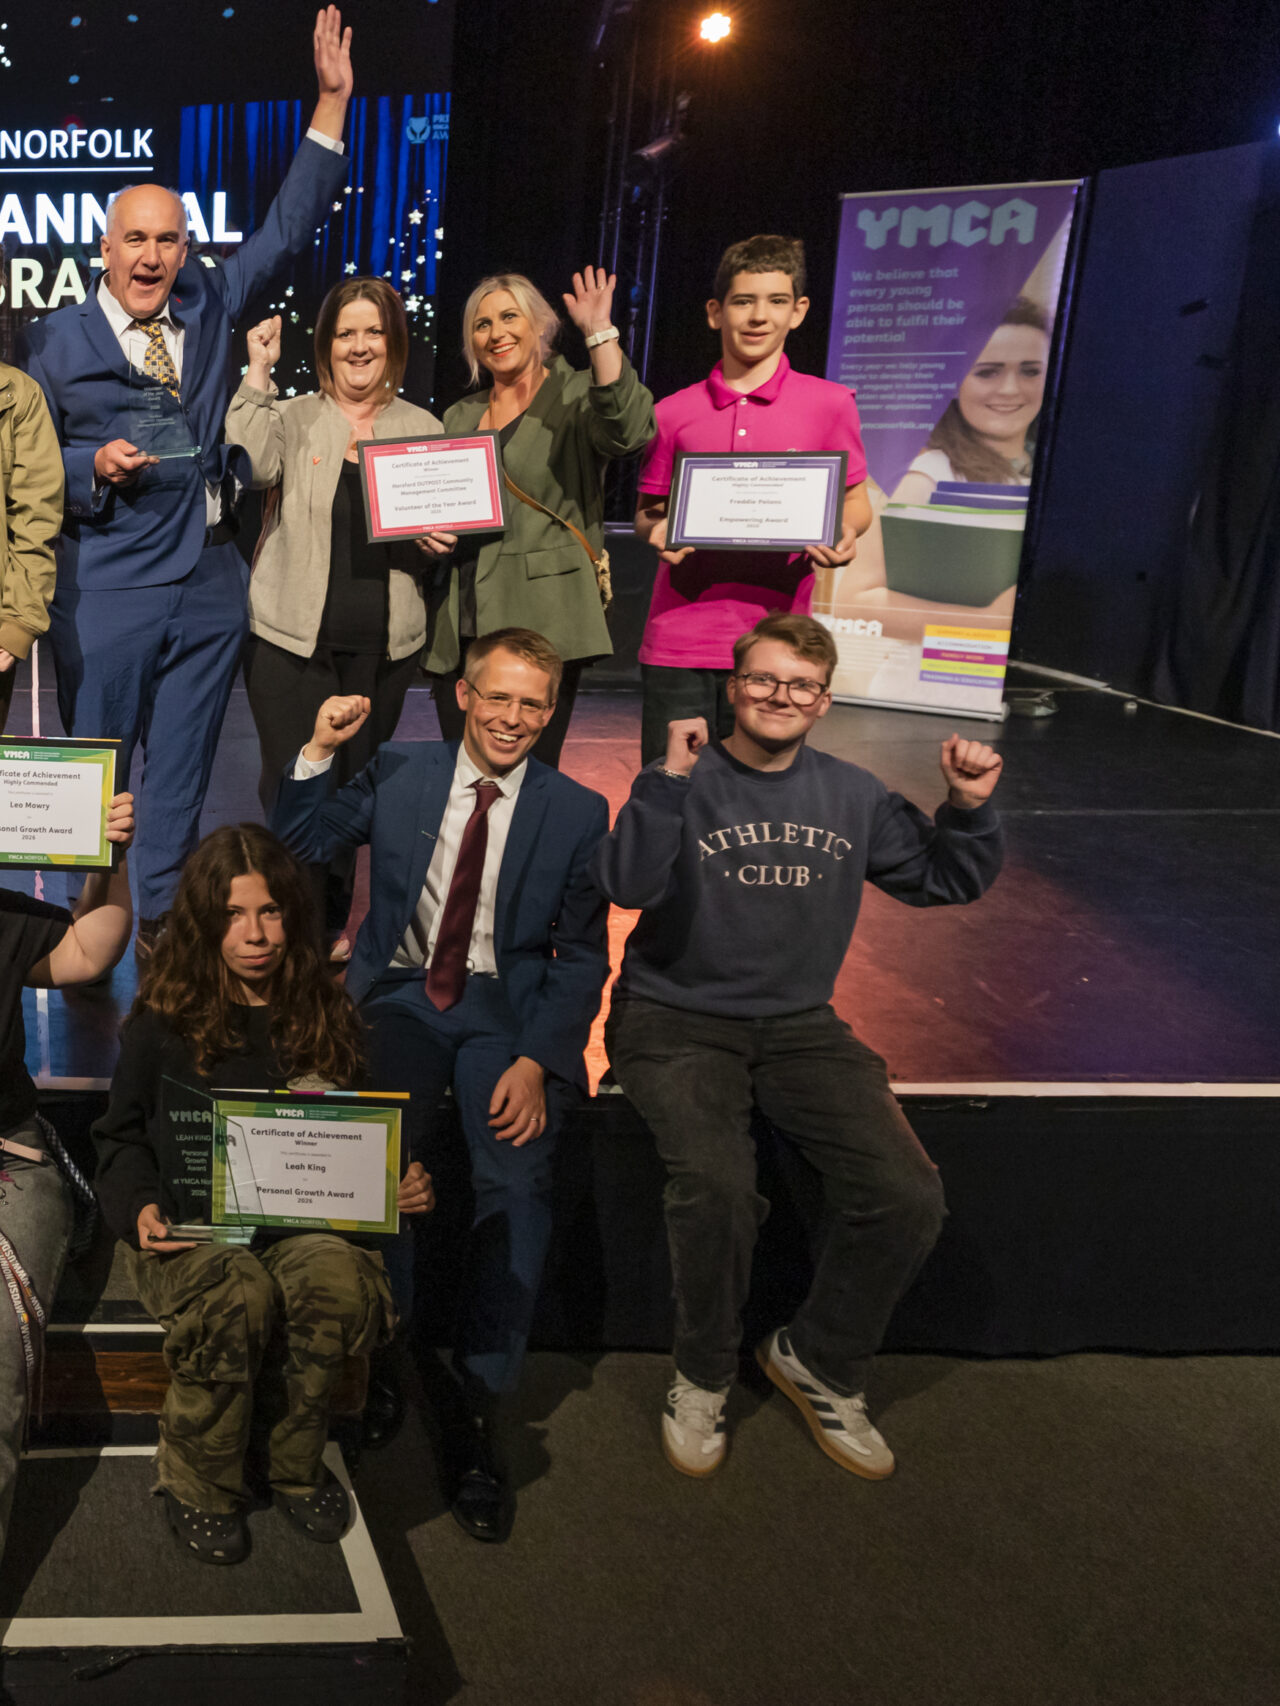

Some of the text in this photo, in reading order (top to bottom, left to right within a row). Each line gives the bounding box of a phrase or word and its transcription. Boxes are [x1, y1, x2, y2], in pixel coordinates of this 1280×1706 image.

[0, 129, 153, 159] NORFOLK
[857, 198, 1037, 250] YMCA
[851, 268, 959, 281] We believe that
[850, 286, 932, 299] every young
[848, 299, 964, 315] person should be
[846, 314, 966, 328] able to fulfil their
[844, 331, 906, 346] potential
[400, 488, 435, 496] Management
[3, 750, 30, 759] YMCA
[22, 770, 31, 778] of
[32, 771, 81, 780] Achievement
[3, 779, 22, 787] Highly
[25, 802, 50, 811] Mowry
[20, 825, 47, 833] Growth
[697, 822, 852, 861] ATHLETIC
[737, 865, 810, 886] CLUB
[169, 1110, 212, 1123] YMCA
[275, 1108, 304, 1117] YMCA
[251, 1128, 362, 1141] Certificate of Achievement
[285, 1162, 326, 1173] Leah King
[256, 1186, 354, 1198] Personal Growth Award
[0, 1255, 24, 1313] UNION USDAW
